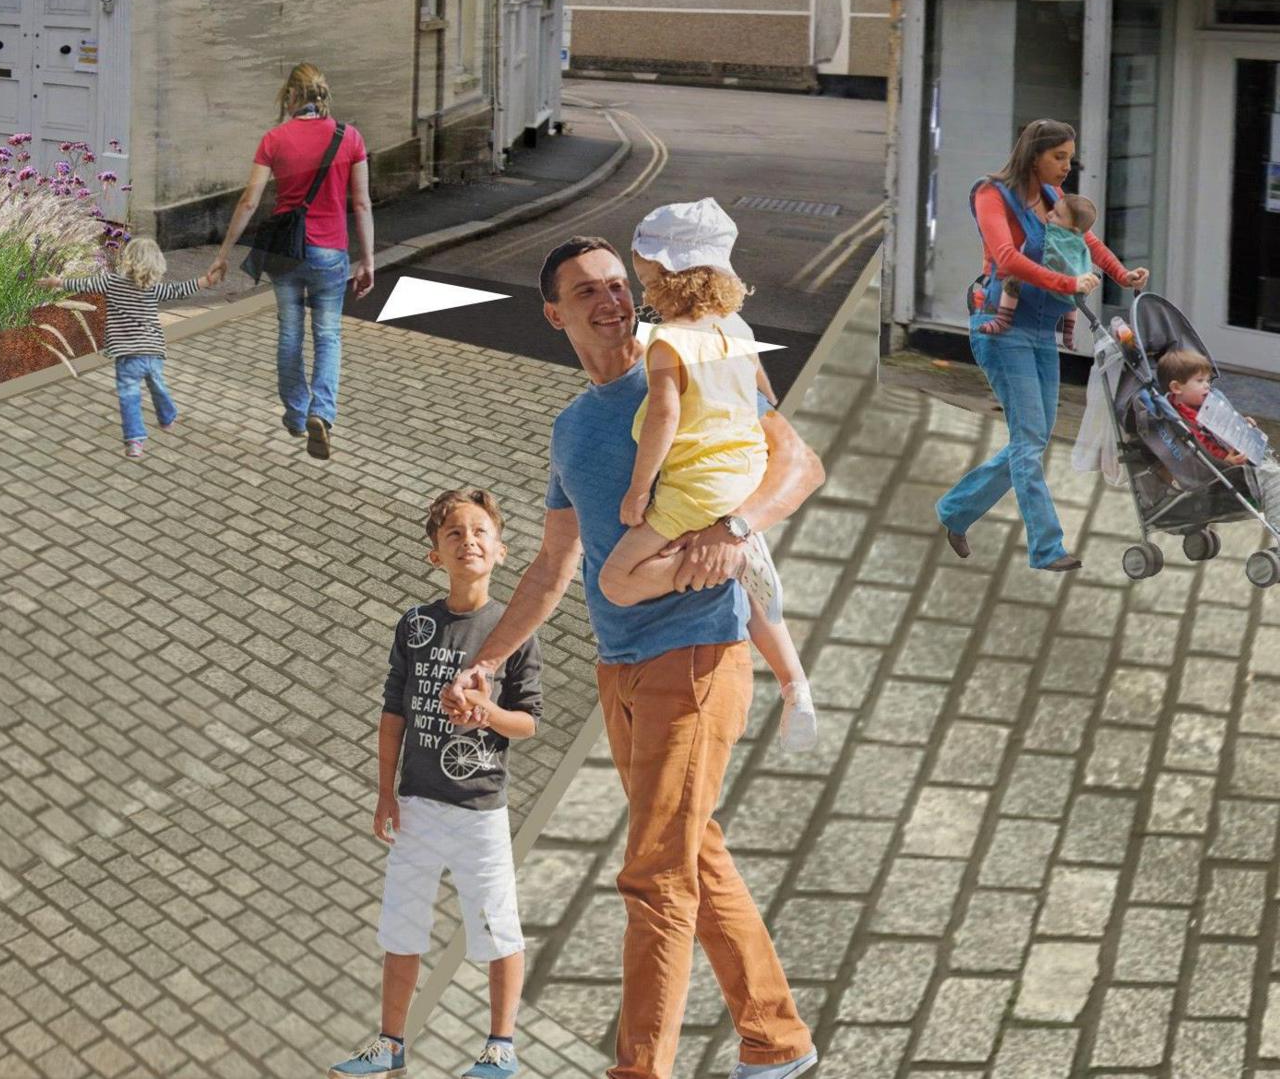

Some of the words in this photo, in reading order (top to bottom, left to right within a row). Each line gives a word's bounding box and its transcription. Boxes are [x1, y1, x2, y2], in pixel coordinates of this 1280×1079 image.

[430, 647, 467, 664] DON'T
[415, 662, 429, 677] BE
[418, 680, 431, 694] TO
[411, 696, 423, 711] BE
[414, 714, 435, 731] NOT
[438, 718, 454, 734] TO
[418, 732, 442, 749] TRY
